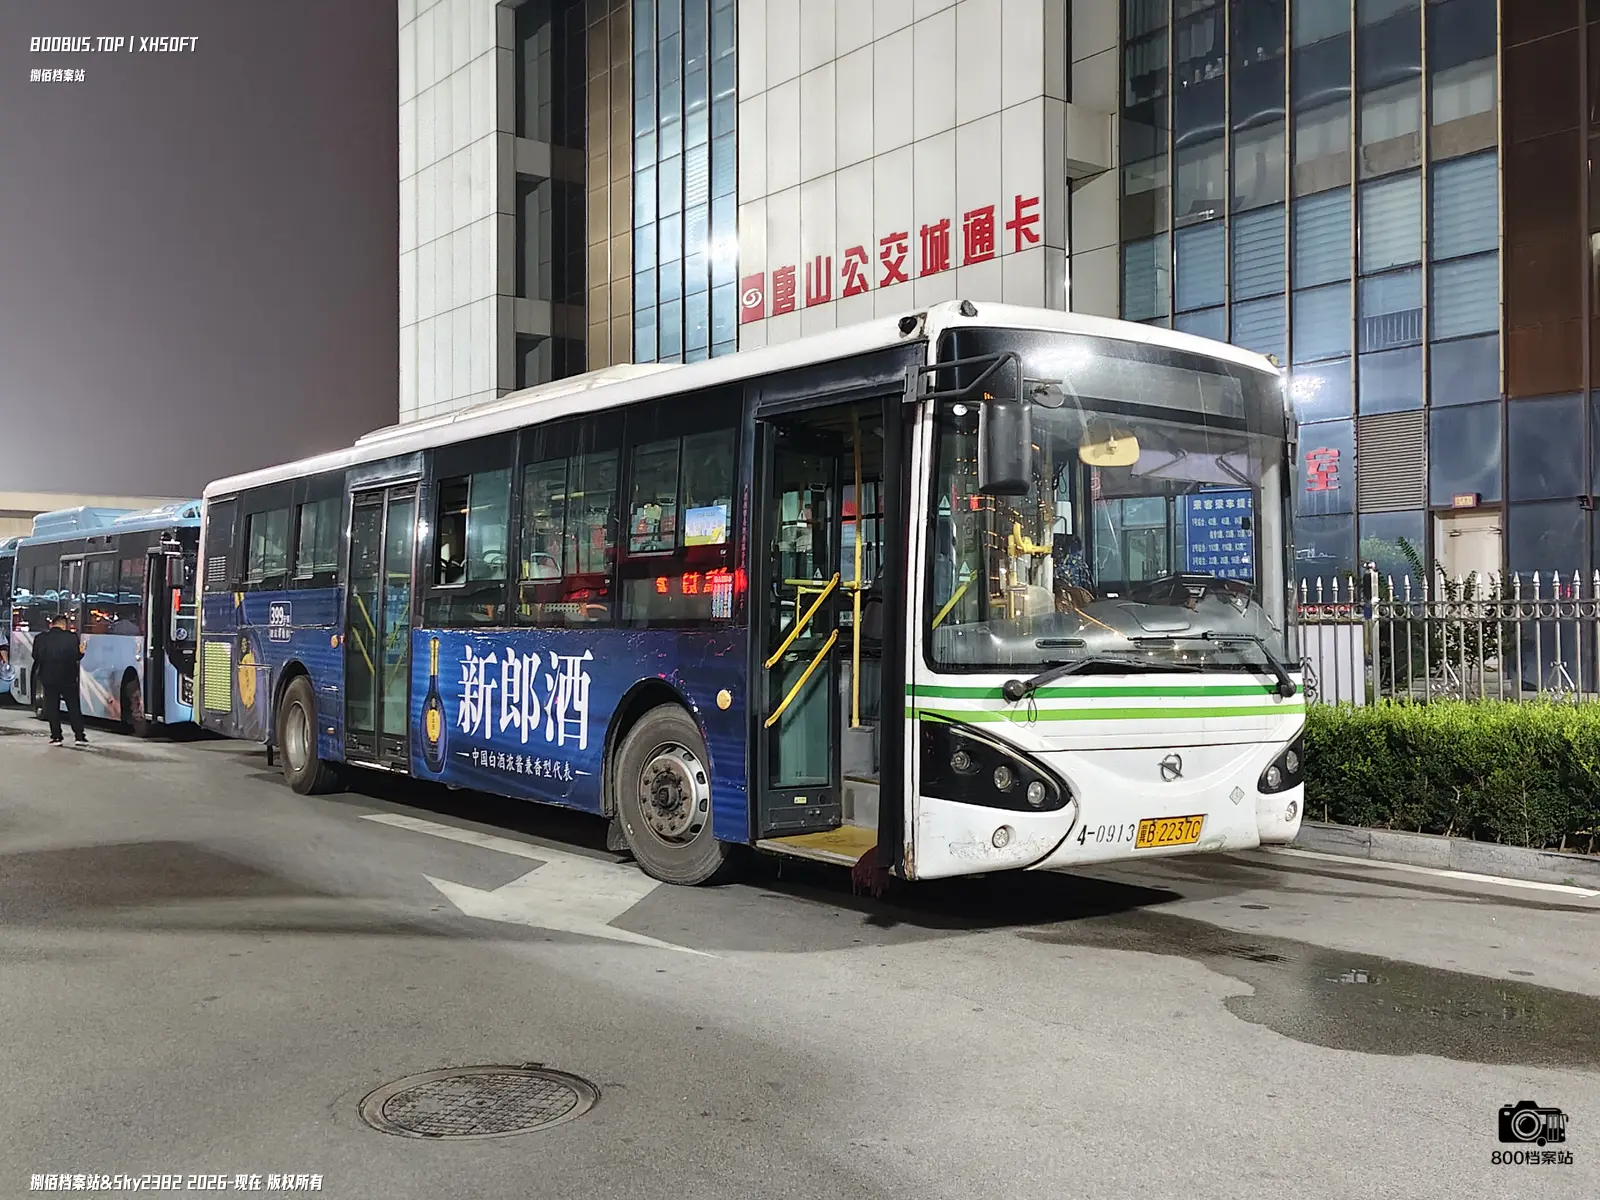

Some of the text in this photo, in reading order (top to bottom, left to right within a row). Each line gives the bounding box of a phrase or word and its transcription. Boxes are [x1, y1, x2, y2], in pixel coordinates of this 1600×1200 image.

[772, 195, 1040, 316] 唐山公交城通卡
[456, 644, 594, 750] 新郎酒
[472, 747, 574, 781] 中国白酒浓酱兼香型代表
[1077, 823, 1136, 846] 4-0913
